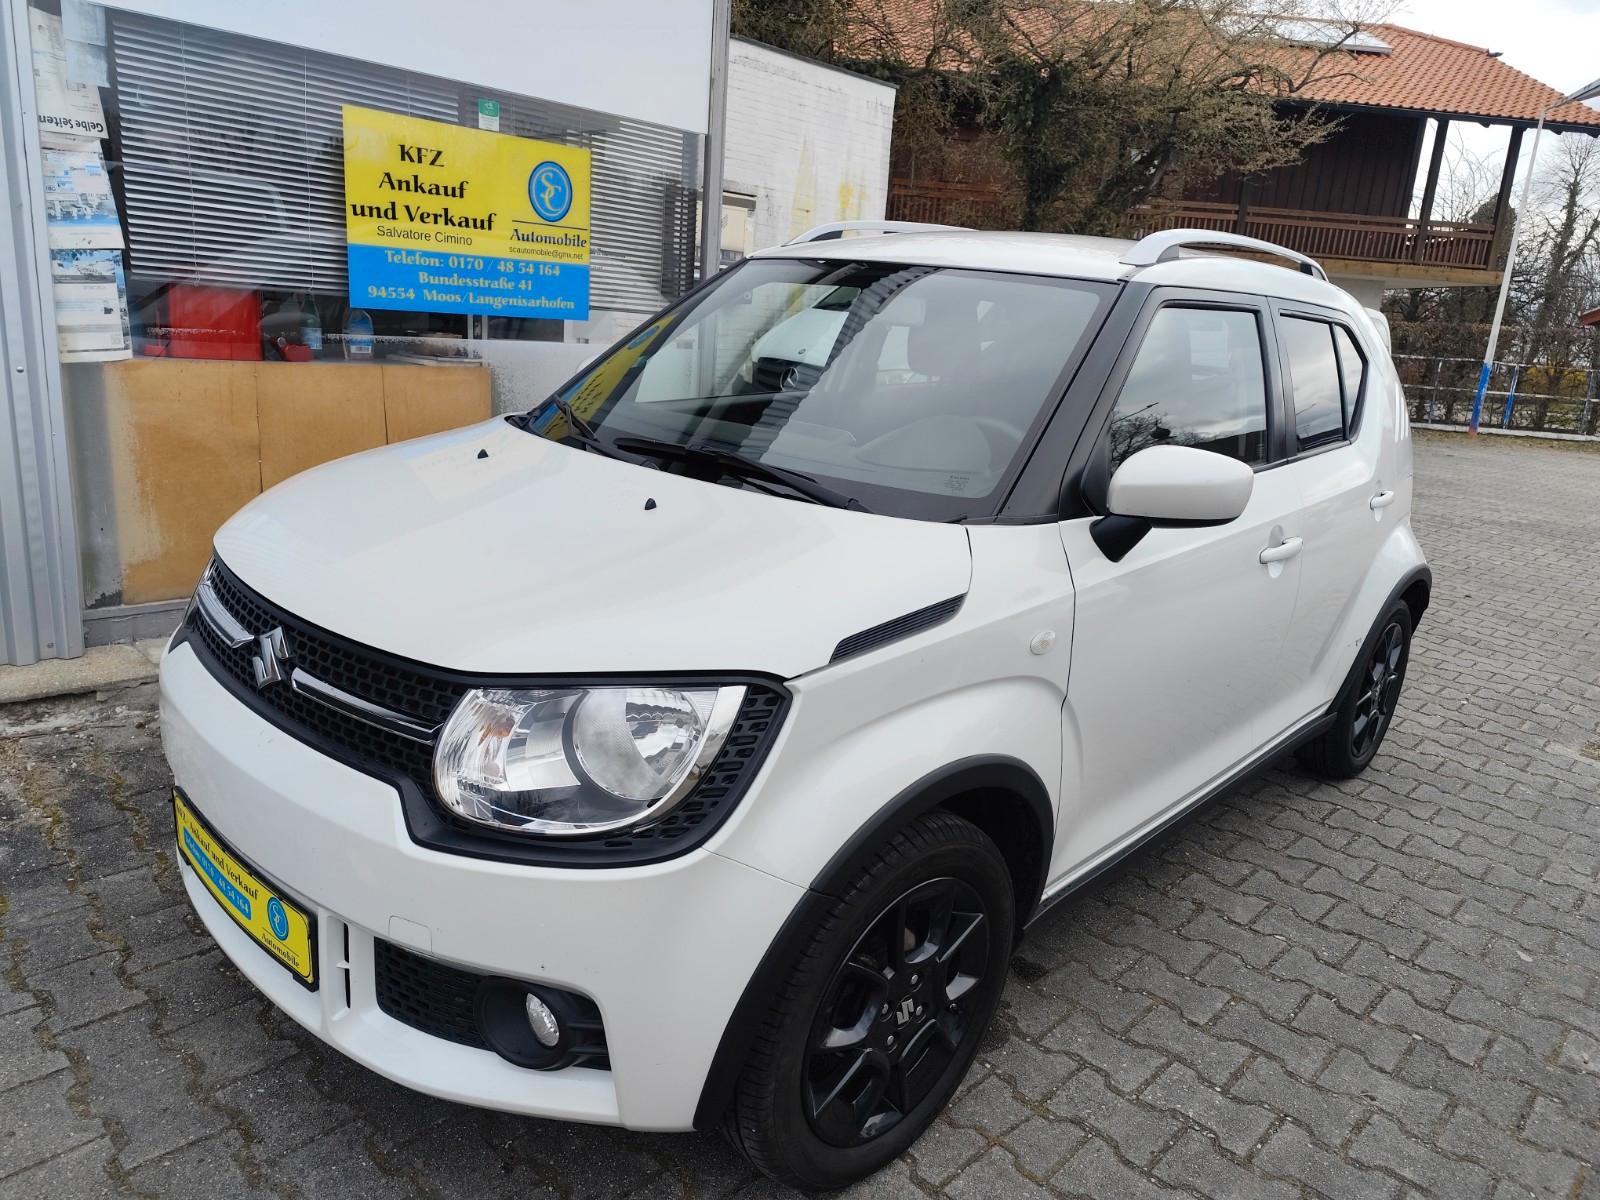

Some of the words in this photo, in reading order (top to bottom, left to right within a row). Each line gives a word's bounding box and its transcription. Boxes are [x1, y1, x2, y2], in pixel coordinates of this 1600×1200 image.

[75, 120, 104, 133] Gelbe
[398, 144, 445, 168] KFZ
[378, 172, 469, 199] Ankauf
[350, 201, 398, 221] und
[403, 204, 498, 231] Verkauf
[376, 225, 432, 242] Salvatore
[435, 231, 474, 246] Cimino
[510, 228, 588, 248] Automobile
[384, 250, 445, 268] Telefon:
[448, 256, 484, 271] 0170
[497, 260, 514, 273] 48
[518, 262, 535, 275] 54
[538, 263, 561, 276] 164
[509, 245, 584, 260] scautomobile@gmx.net
[418, 271, 515, 289] Bundesstraße
[518, 279, 533, 291] 41
[367, 285, 416, 299] 94554
[423, 288, 575, 309] Moos/Langenisarhofen
[226, 863, 260, 901] Verkauf
[261, 932, 300, 969] Automobile
